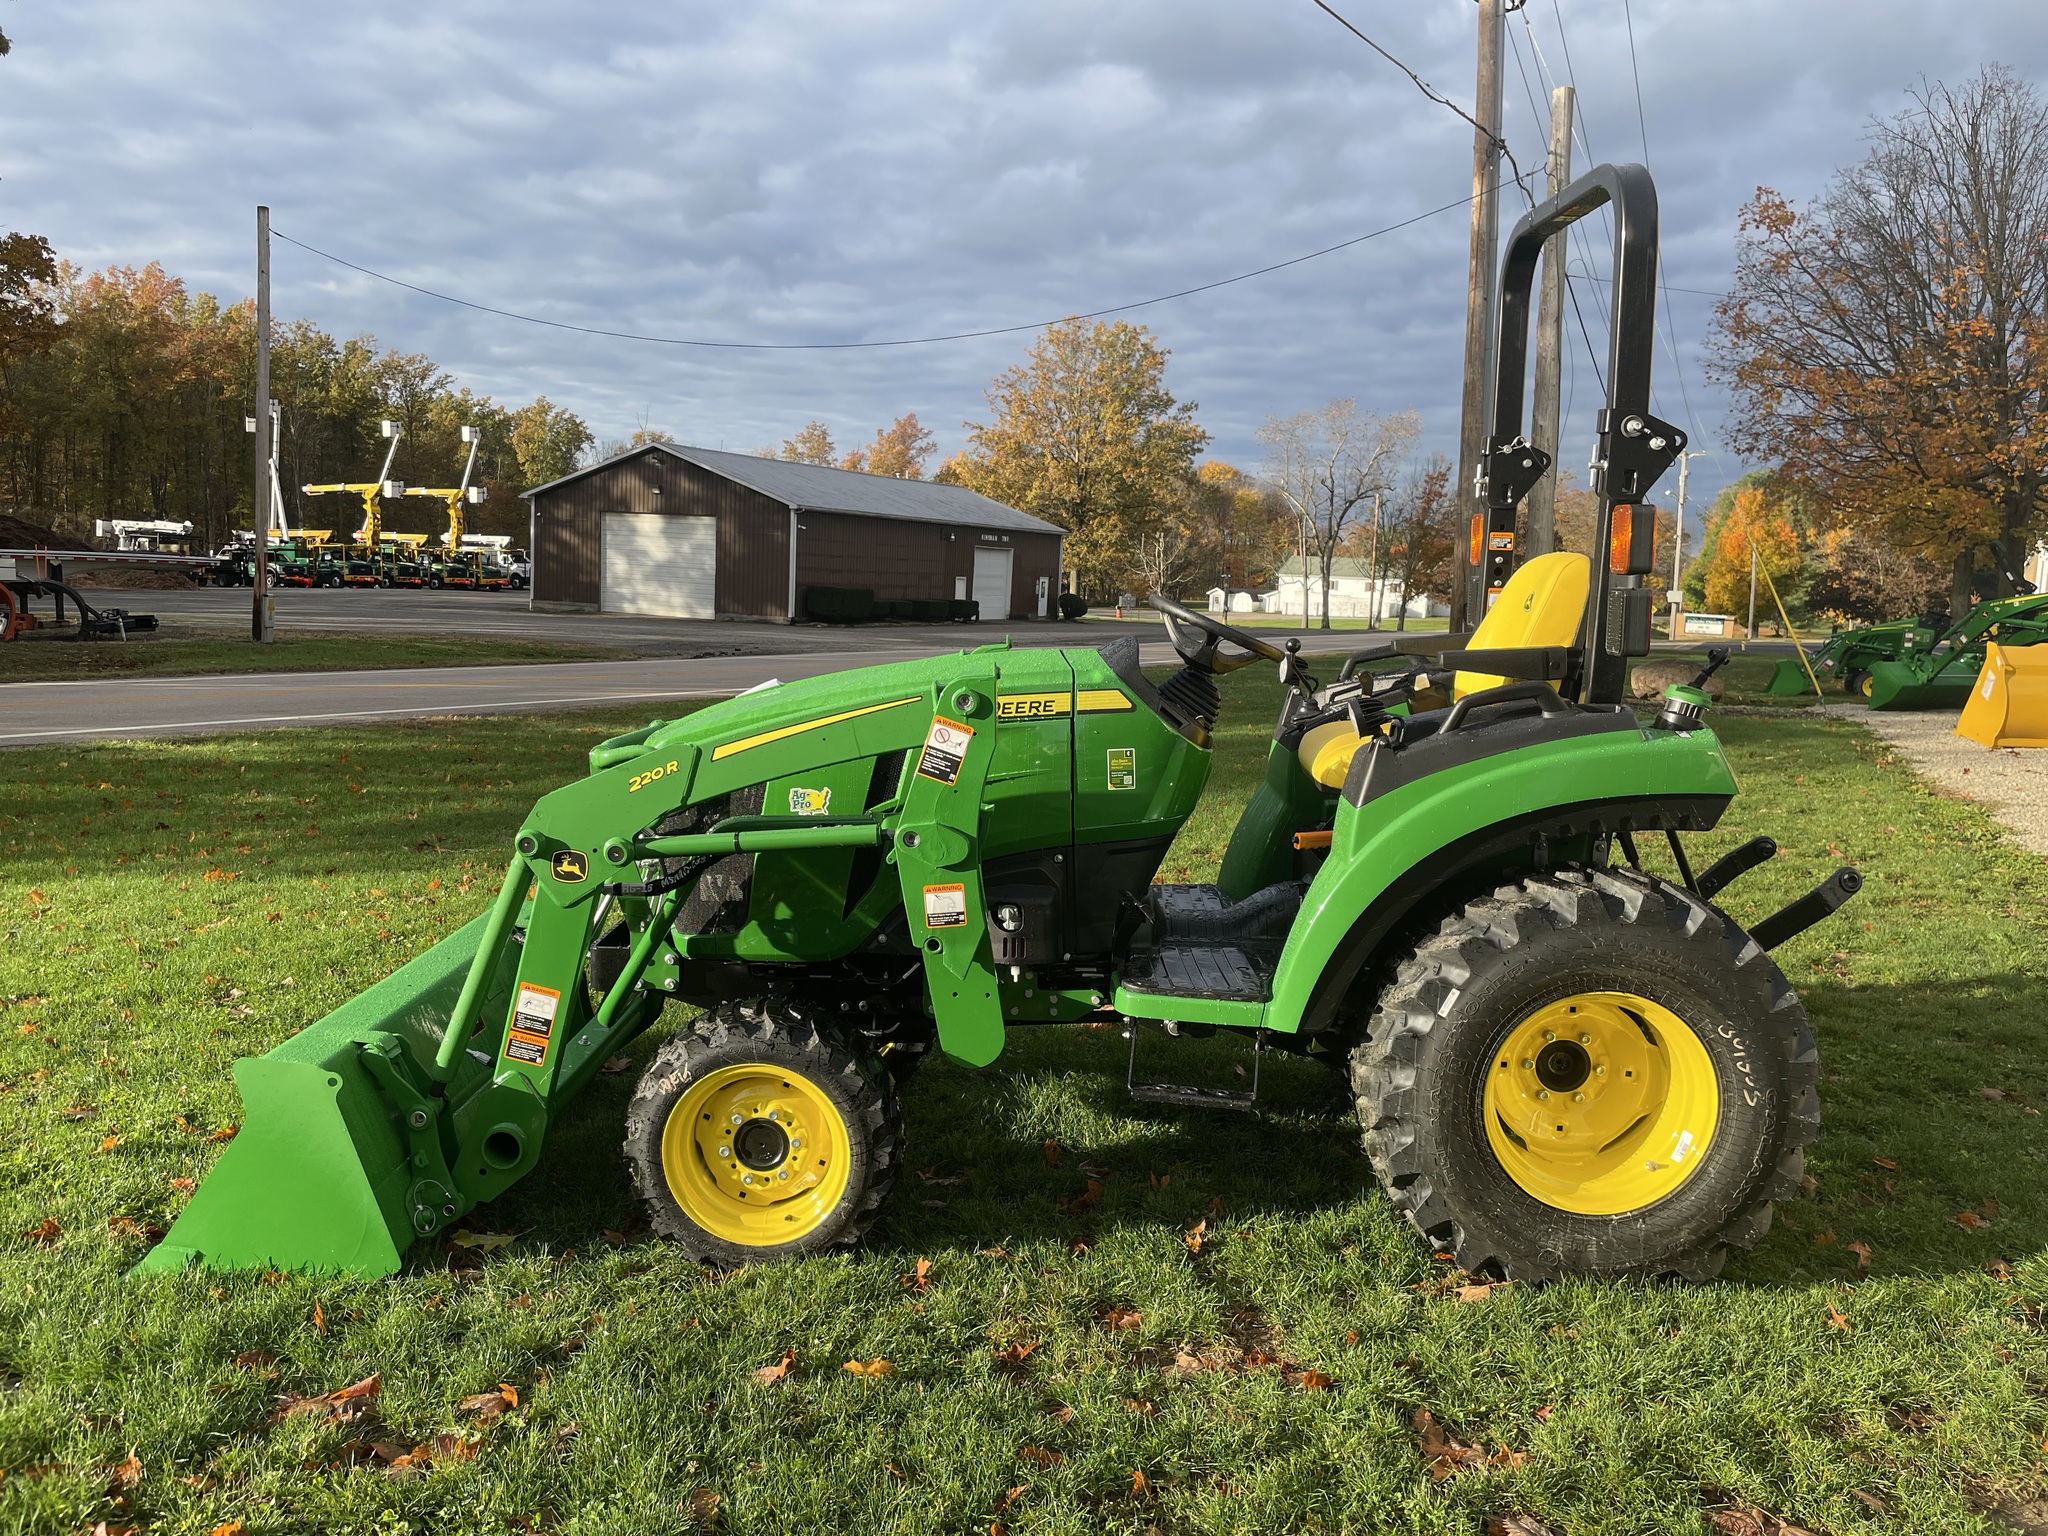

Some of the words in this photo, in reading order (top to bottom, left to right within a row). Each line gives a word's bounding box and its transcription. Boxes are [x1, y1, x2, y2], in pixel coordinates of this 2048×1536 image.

[998, 700, 1055, 715] EERE
[943, 719, 972, 734] WARNING
[792, 790, 810, 801] Ag-
[793, 800, 811, 809] Pro
[531, 987, 556, 997] WARNING
[520, 1036, 545, 1045] WARNING
[1715, 1087, 1778, 1224] GALAXY
